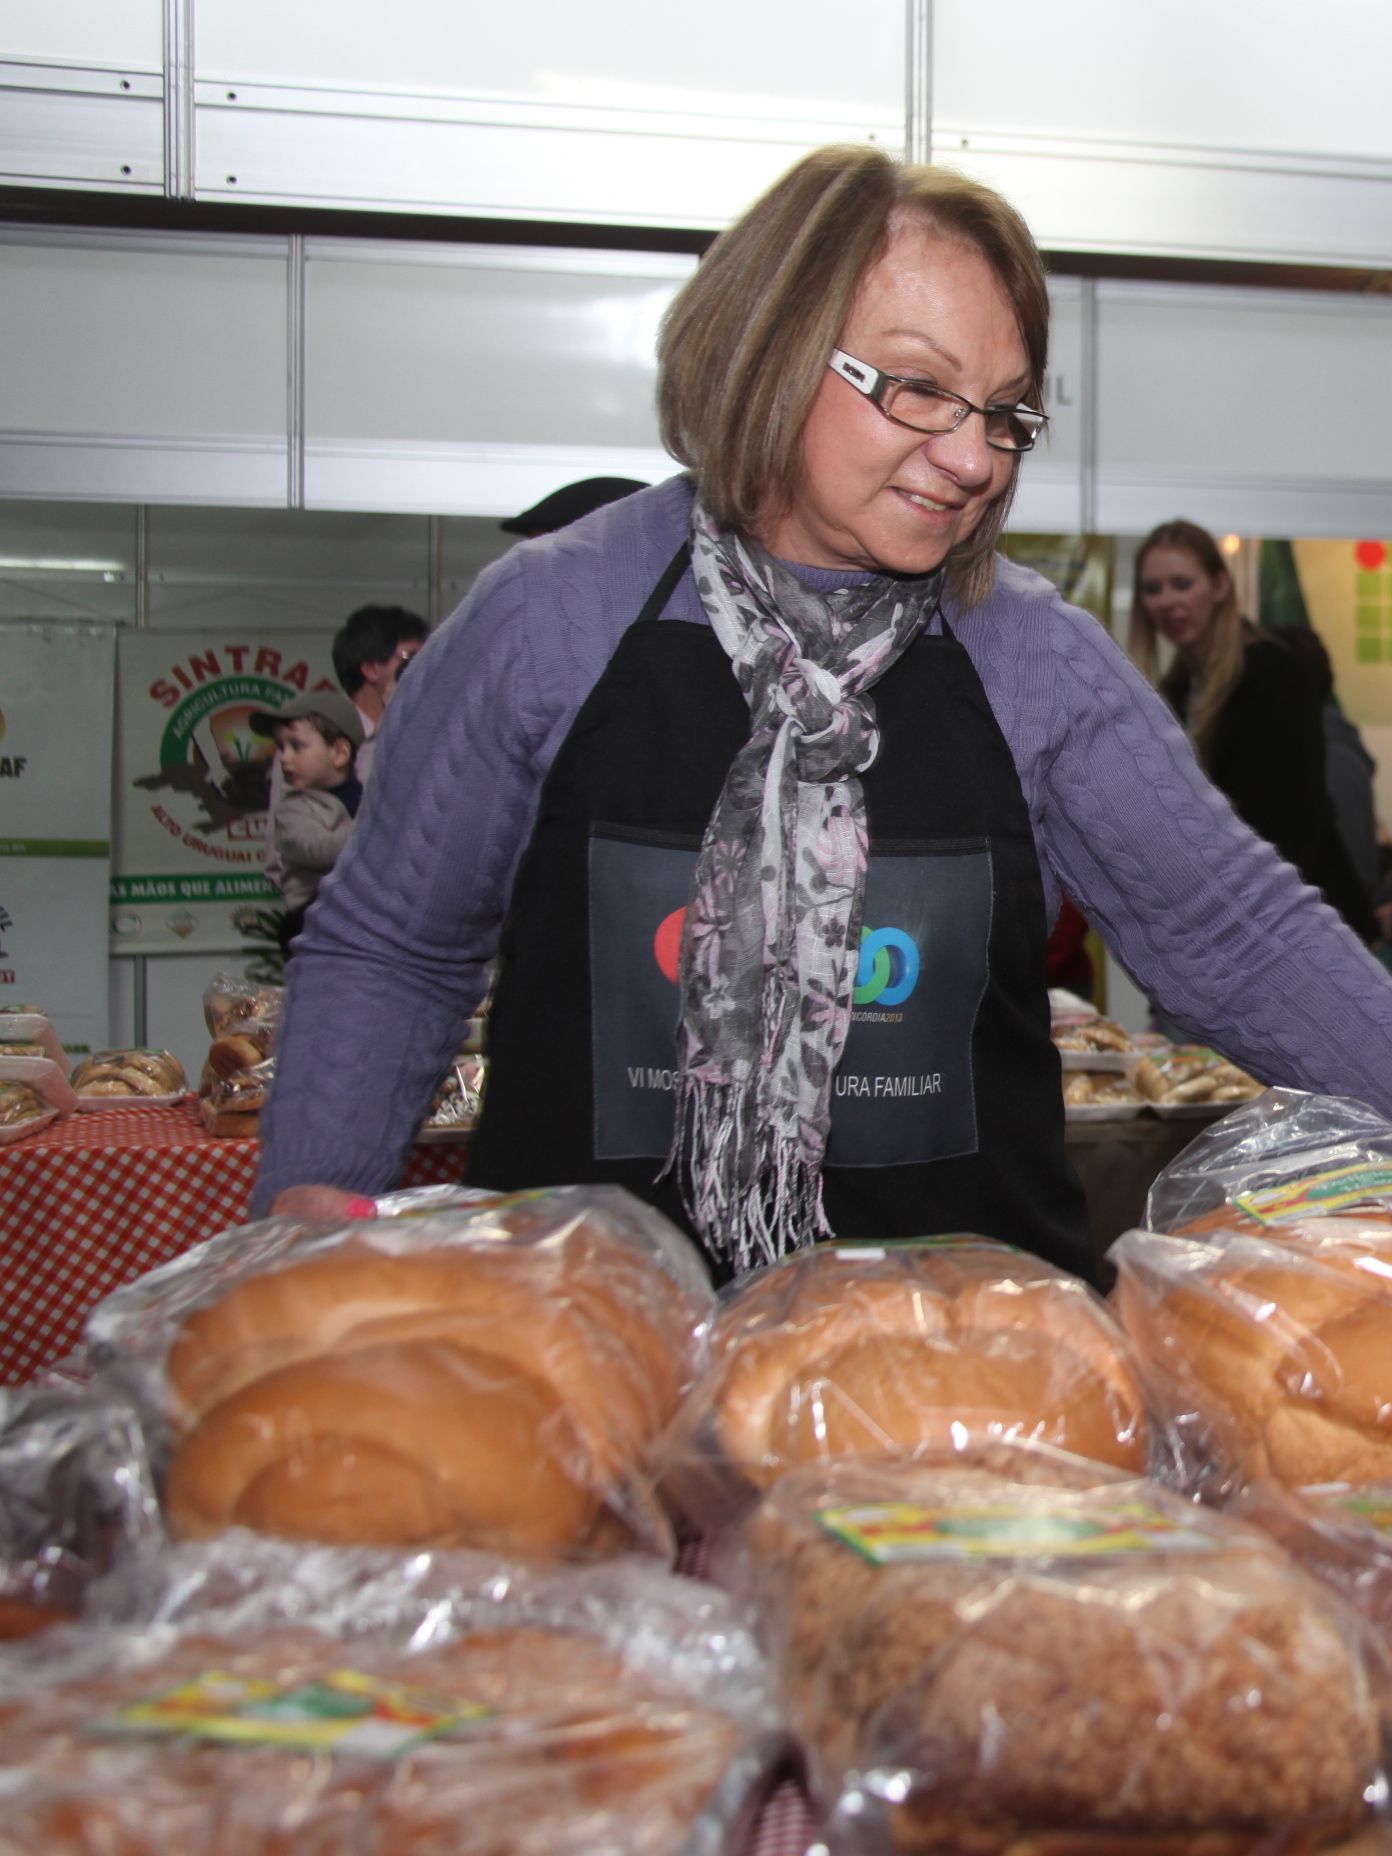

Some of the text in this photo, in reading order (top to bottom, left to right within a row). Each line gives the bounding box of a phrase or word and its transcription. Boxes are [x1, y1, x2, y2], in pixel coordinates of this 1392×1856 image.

[131, 878, 177, 897] MÃOS
[180, 879, 211, 898] QUE
[215, 878, 275, 897] ALIMEN
[836, 1075, 871, 1097] URA
[874, 1073, 942, 1098] FAMILIAR
